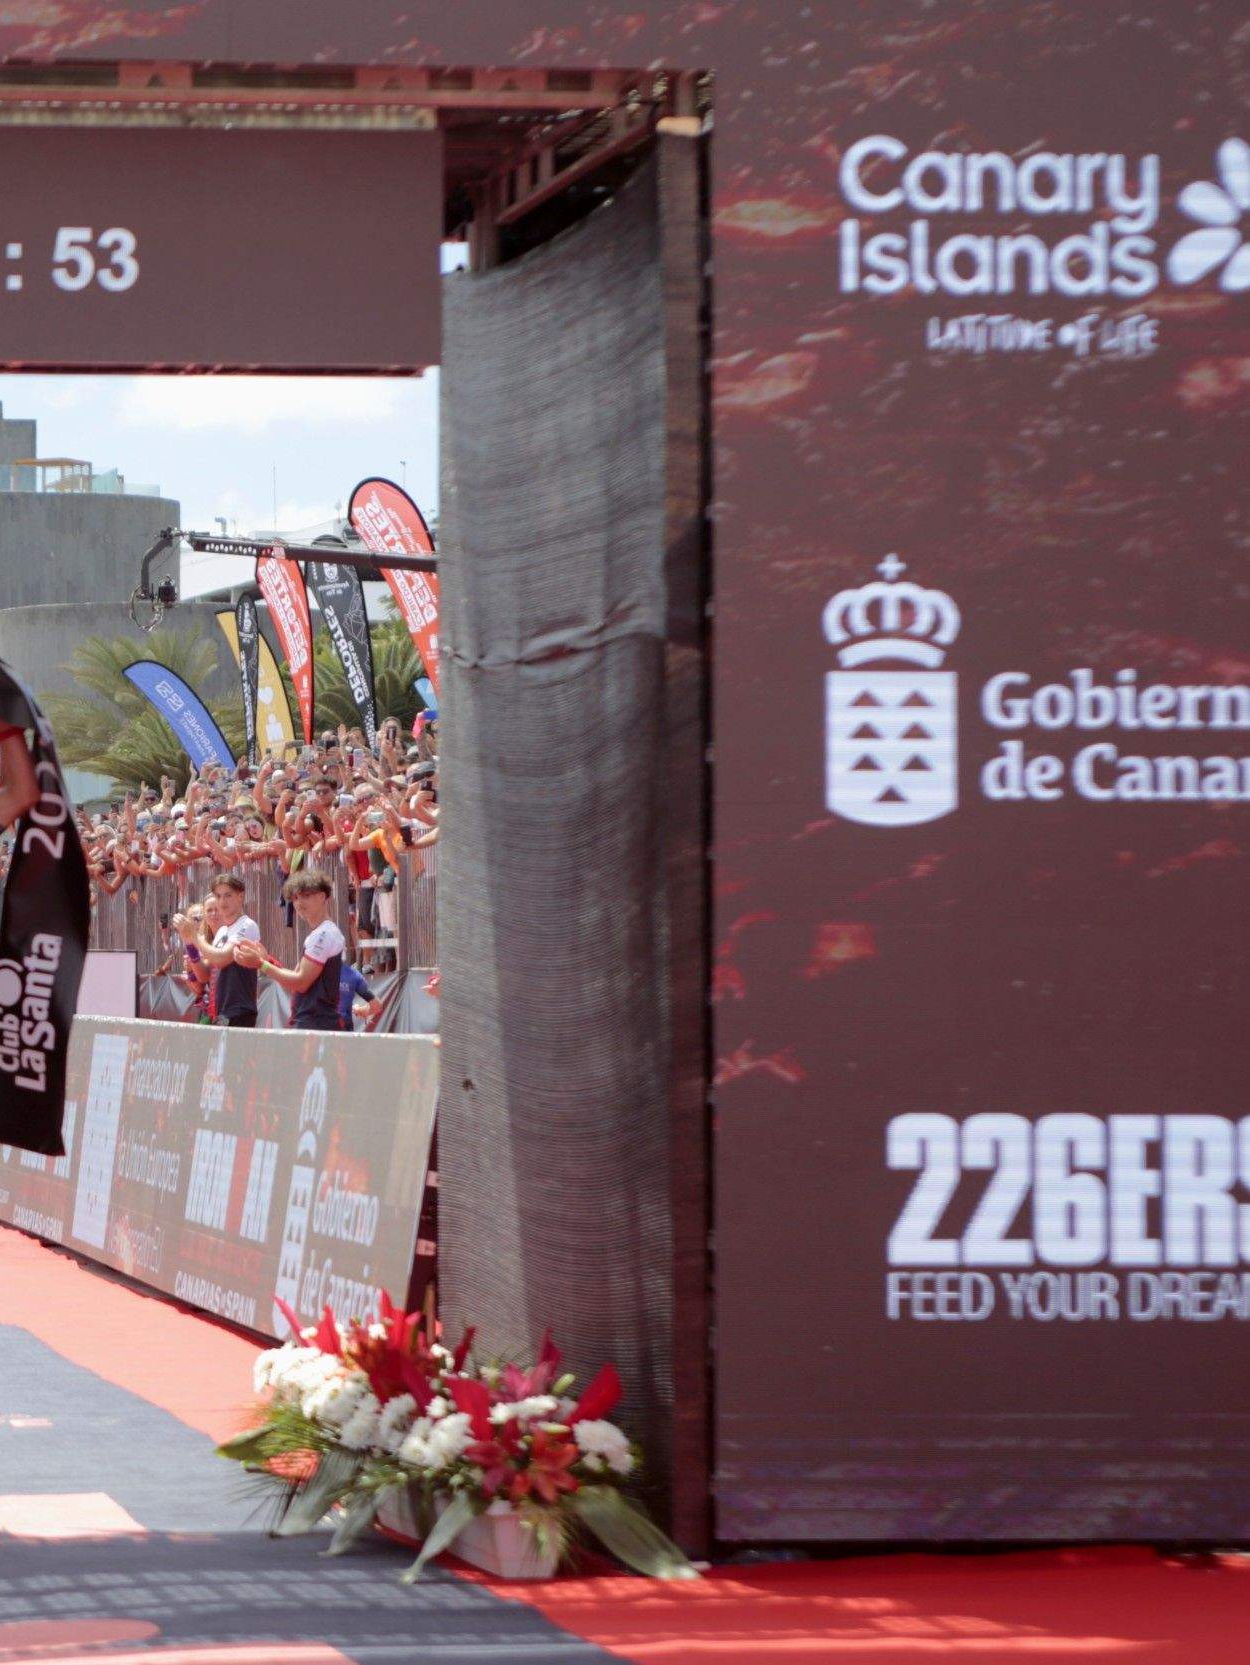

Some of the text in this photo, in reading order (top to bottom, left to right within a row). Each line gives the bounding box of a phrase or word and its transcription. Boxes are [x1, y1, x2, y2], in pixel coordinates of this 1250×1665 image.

[839, 134, 1161, 234] Canary
[52, 227, 140, 292] 53
[838, 218, 1161, 297] Islands
[981, 739, 1065, 801] de
[311, 1168, 380, 1247] Gobierno
[885, 1271, 995, 1322] FEED
[1000, 1271, 1121, 1322] YOUR
